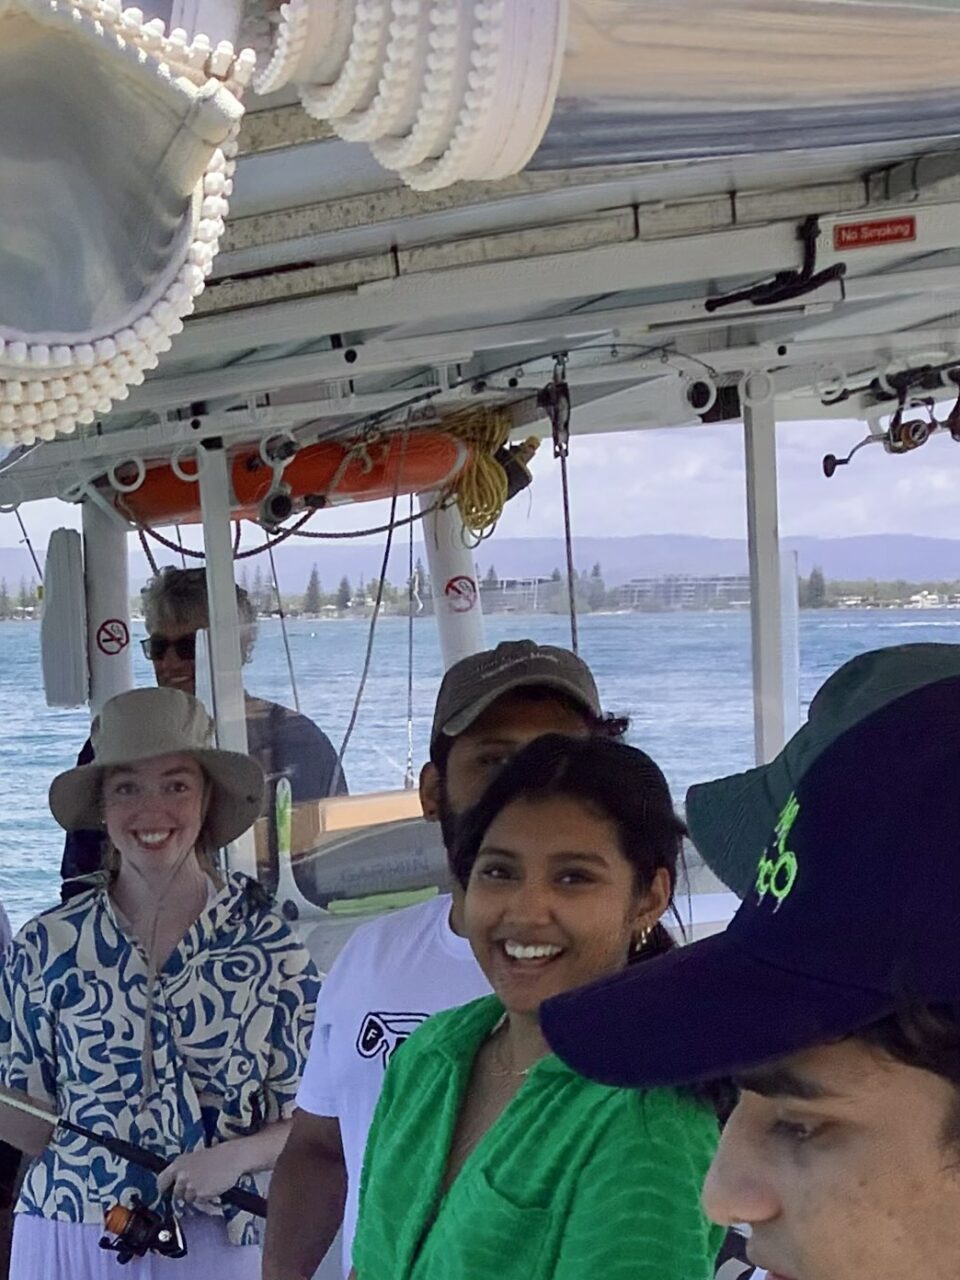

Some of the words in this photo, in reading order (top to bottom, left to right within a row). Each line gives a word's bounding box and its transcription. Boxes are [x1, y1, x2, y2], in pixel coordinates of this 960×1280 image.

[841, 229, 858, 242] No
[860, 224, 911, 240] Smoking
[366, 1029, 378, 1041] F
